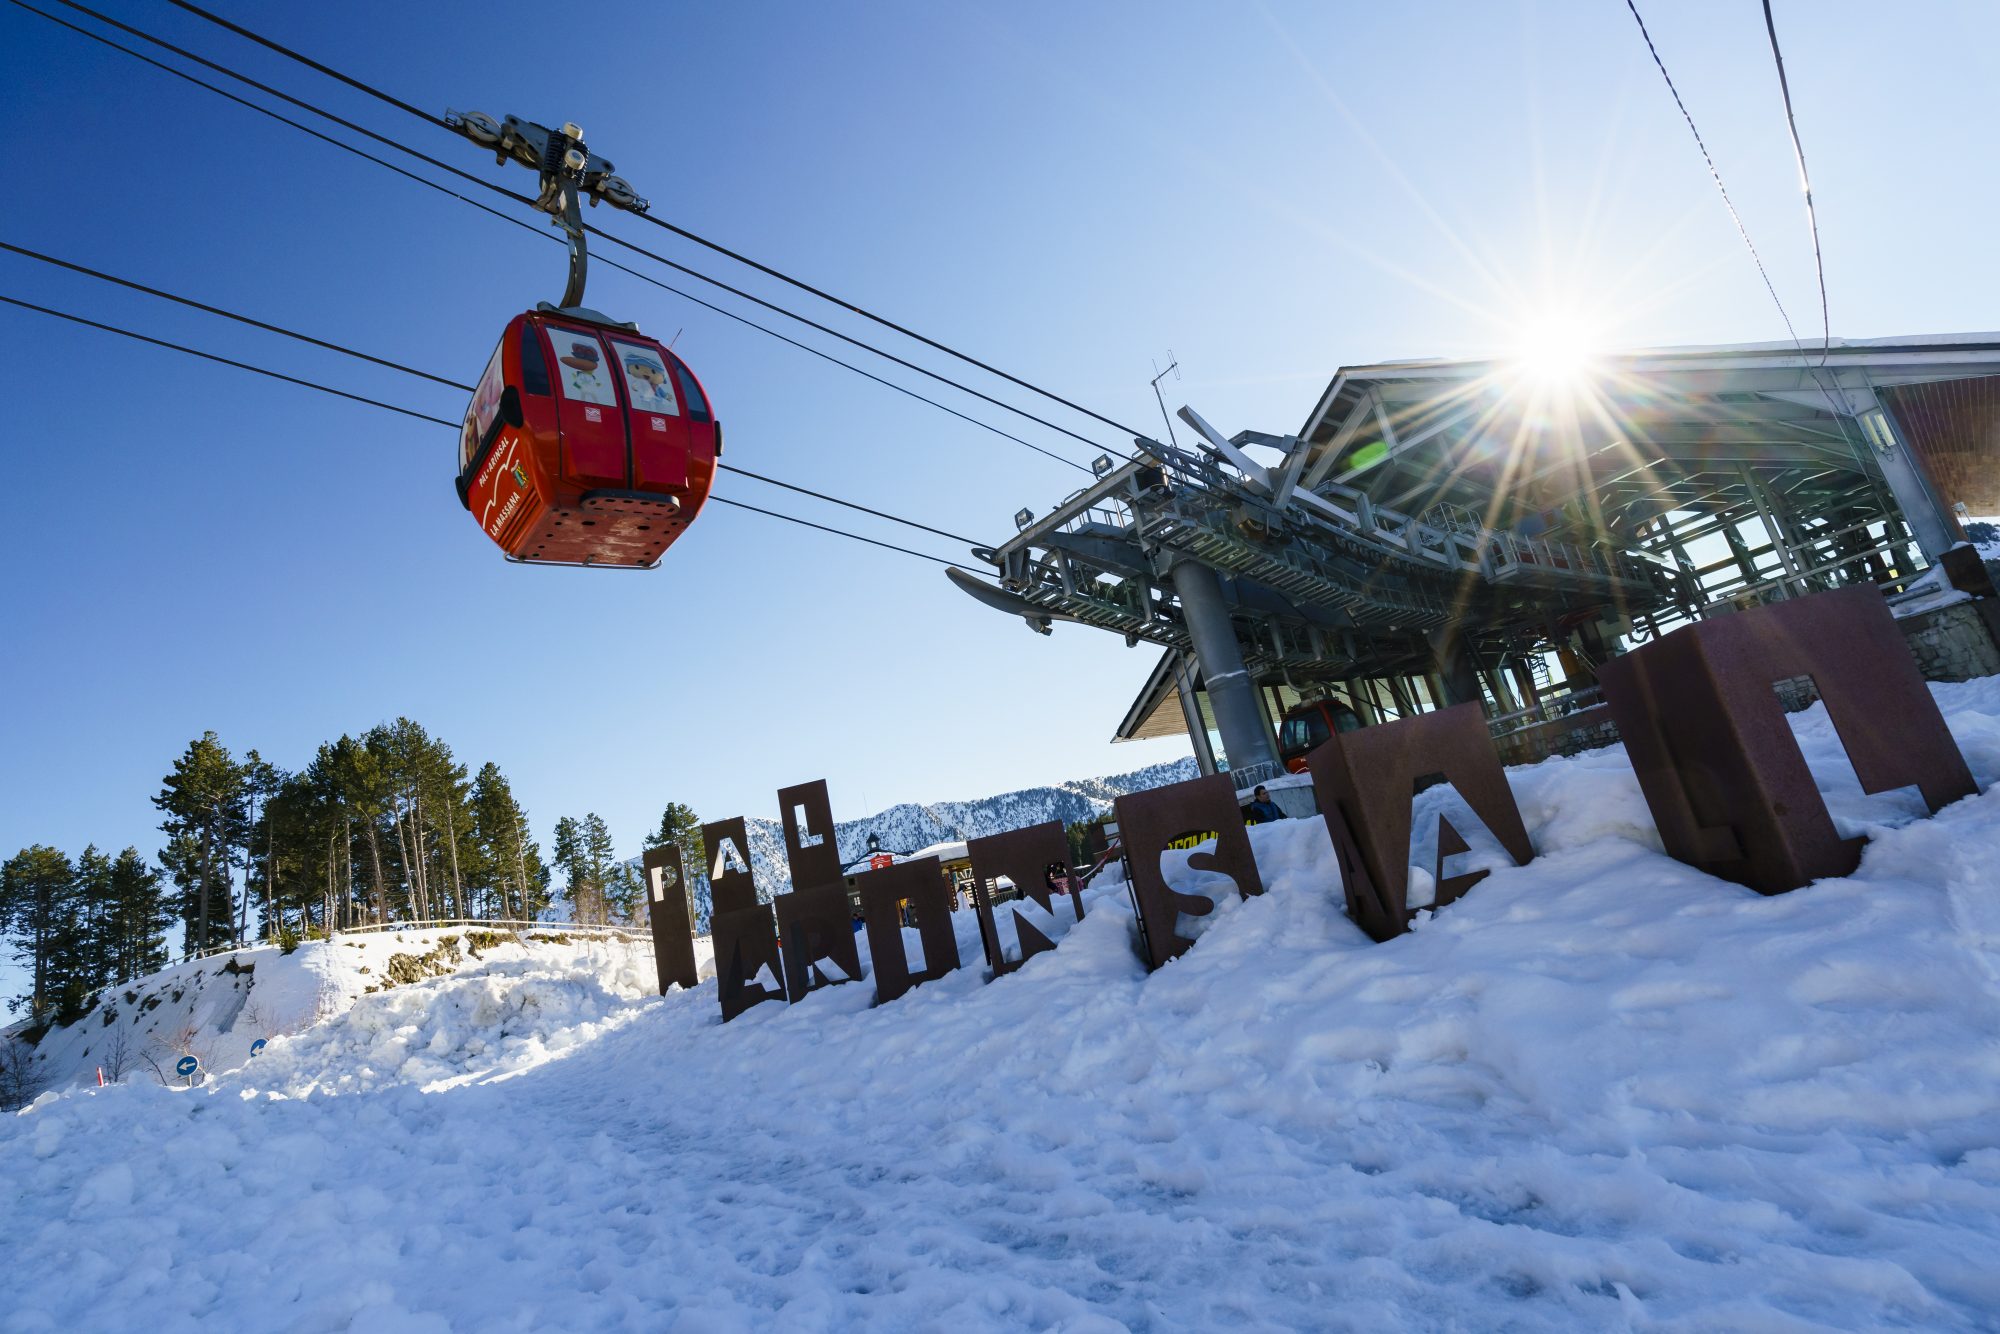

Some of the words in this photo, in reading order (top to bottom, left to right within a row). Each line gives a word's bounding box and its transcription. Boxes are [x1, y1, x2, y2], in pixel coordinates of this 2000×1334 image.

[489, 524, 499, 537] LA
[495, 491, 520, 528] MASSANA
[651, 803, 825, 903] PAL
